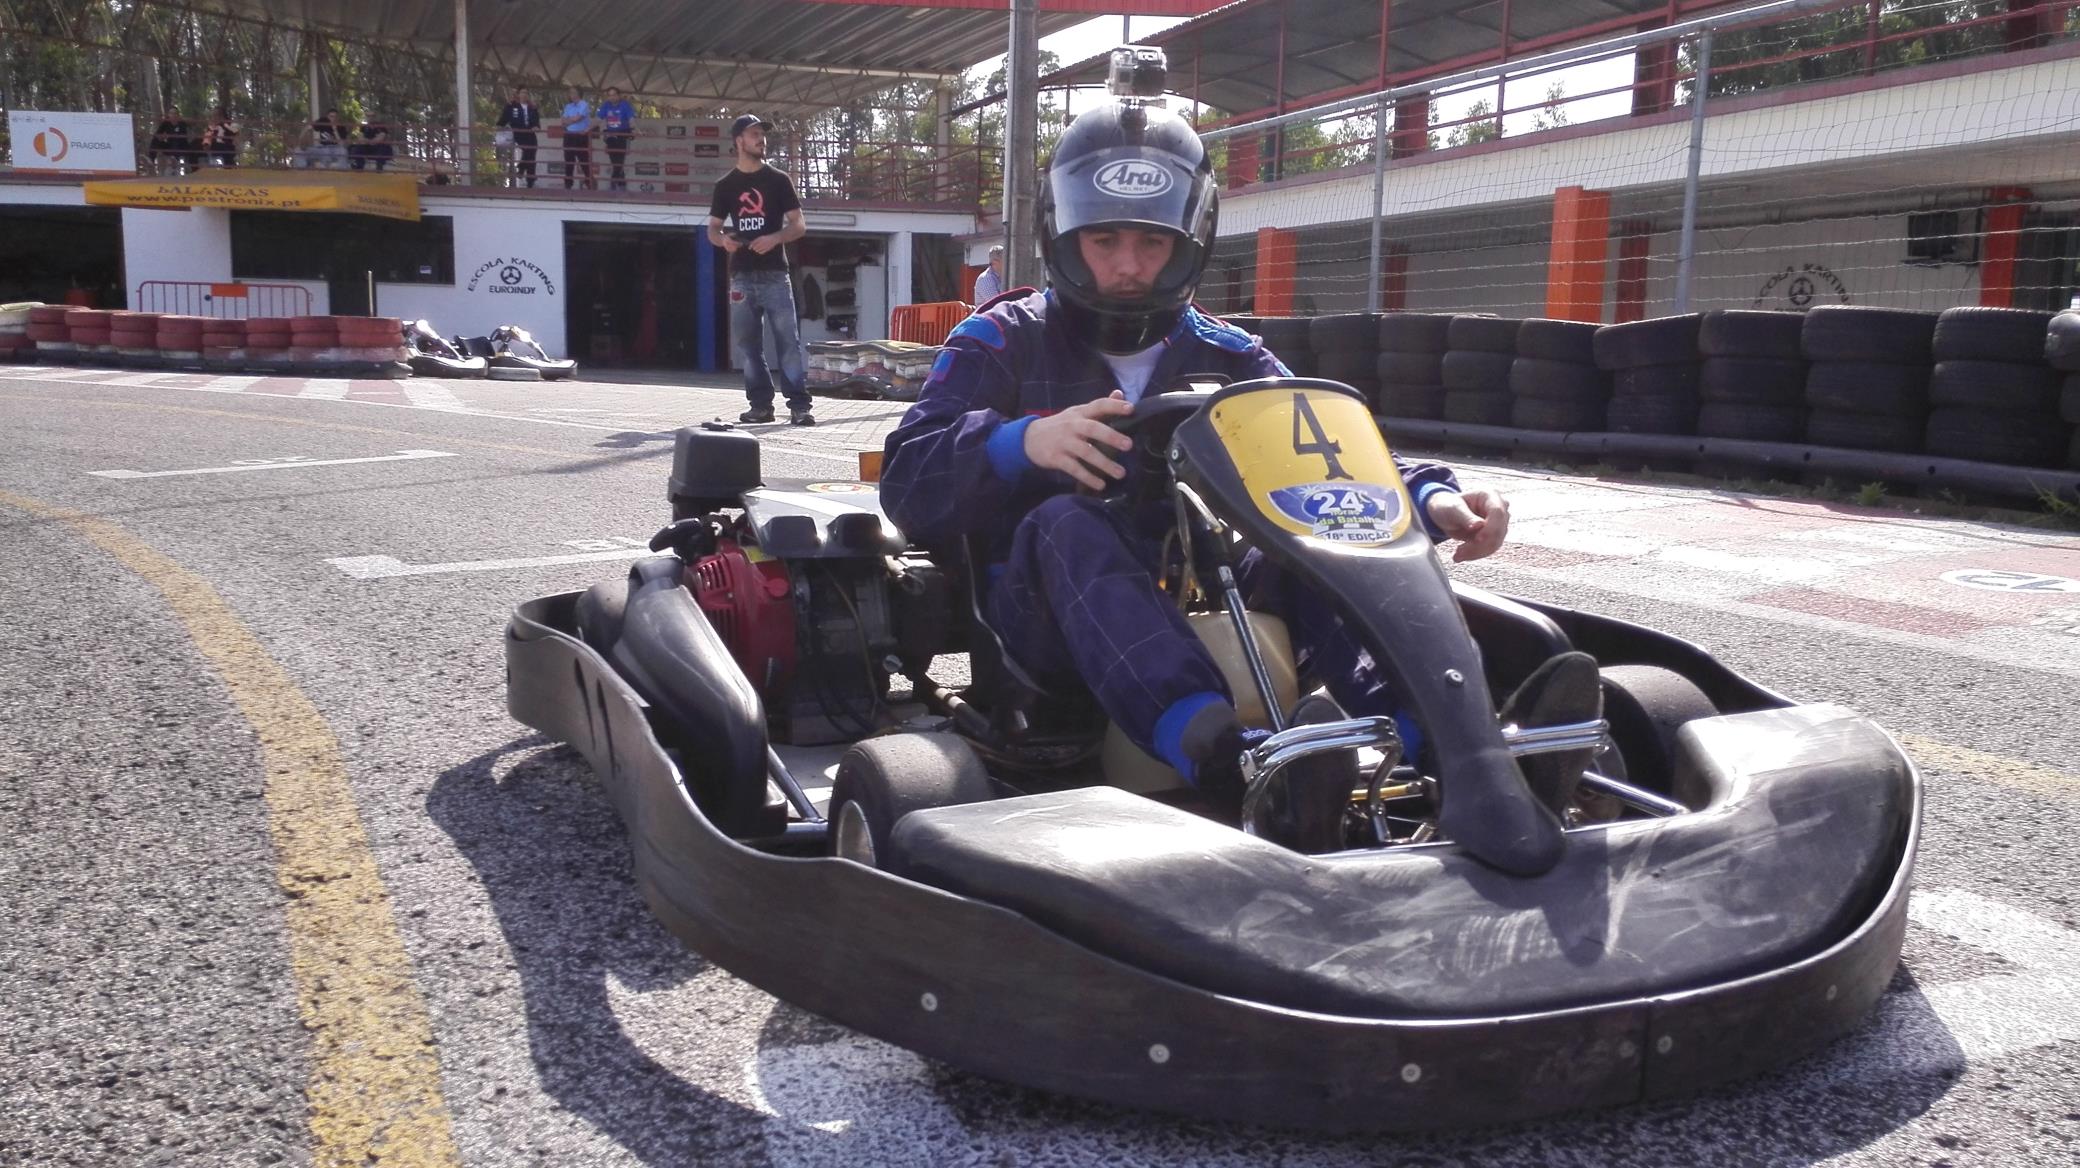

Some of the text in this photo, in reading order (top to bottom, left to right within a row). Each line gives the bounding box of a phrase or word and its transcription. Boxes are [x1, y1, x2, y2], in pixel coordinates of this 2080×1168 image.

[71, 141, 112, 150] PRAGOSA
[1101, 164, 1162, 187] Arai
[739, 217, 765, 231] CCCP
[467, 257, 556, 295] ESCOLA KARTING
[489, 285, 536, 294] EUROINDY
[1293, 392, 1354, 481] 4
[1320, 515, 1382, 526] da Batalha
